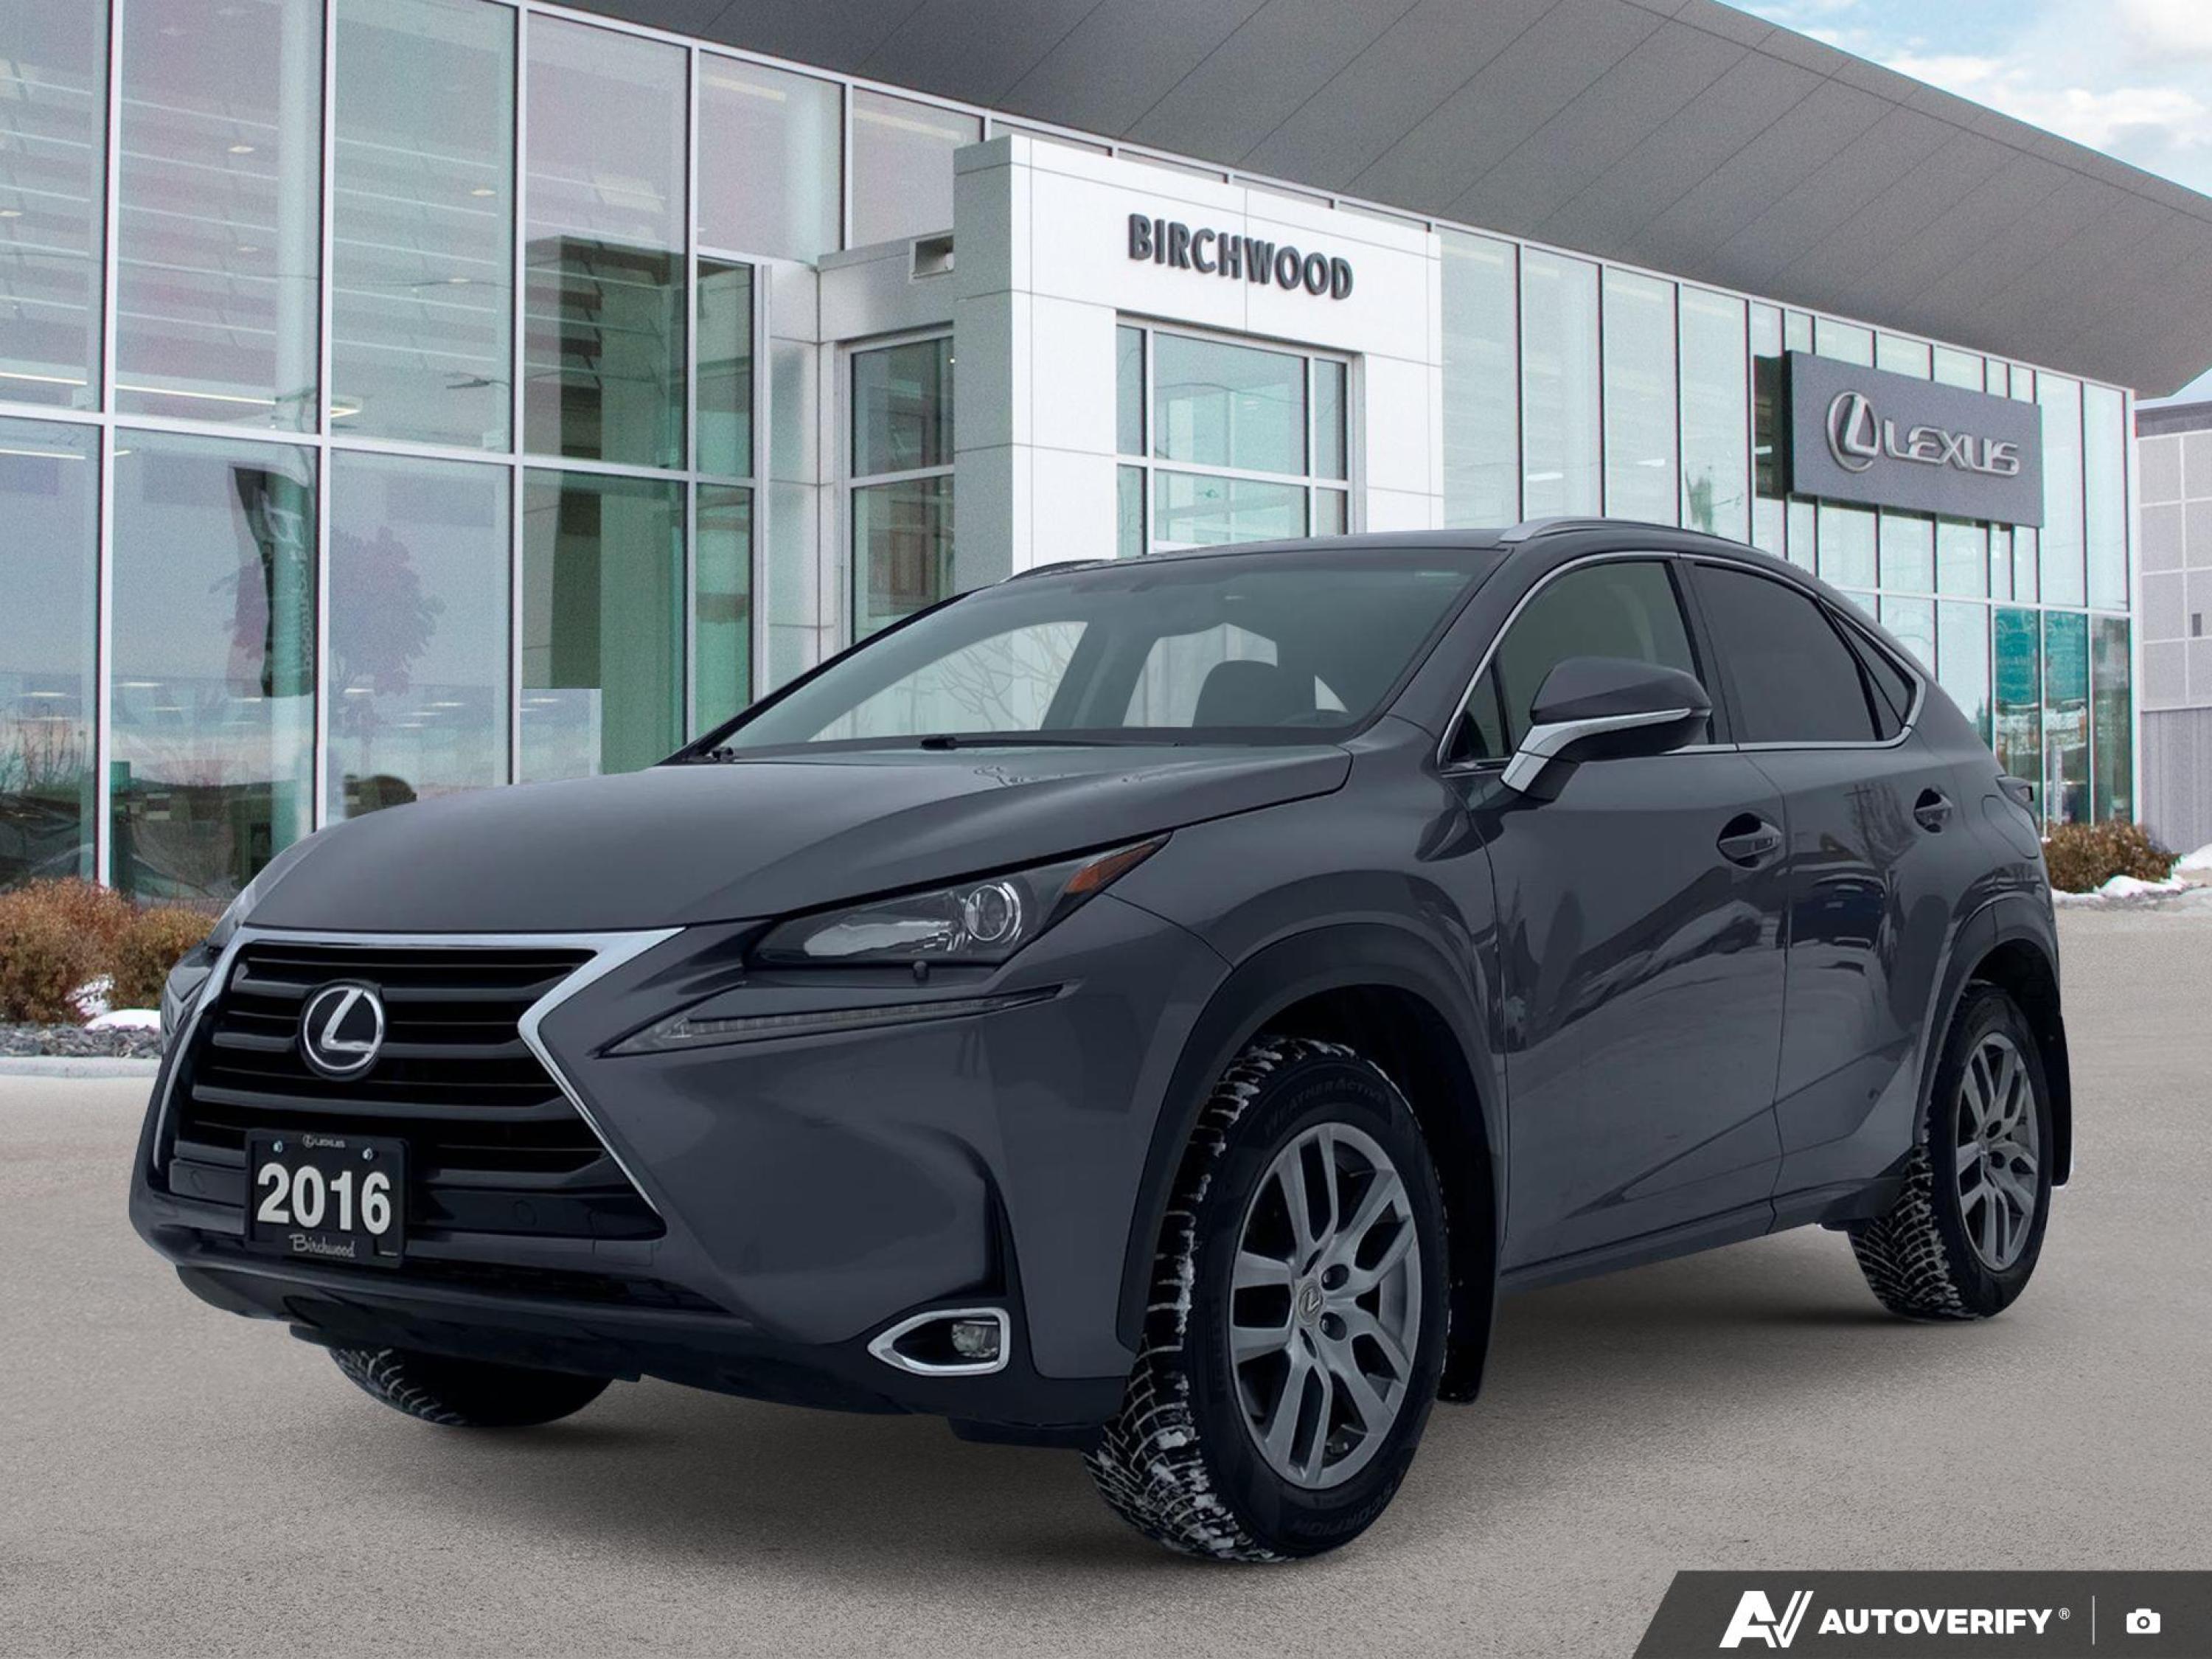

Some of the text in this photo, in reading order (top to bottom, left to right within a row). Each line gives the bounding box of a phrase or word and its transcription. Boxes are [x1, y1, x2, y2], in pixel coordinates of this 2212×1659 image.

[1128, 213, 1354, 300] BIRCHWOOD
[1883, 418, 2020, 476] LEXUS
[257, 1163, 392, 1235] 2016
